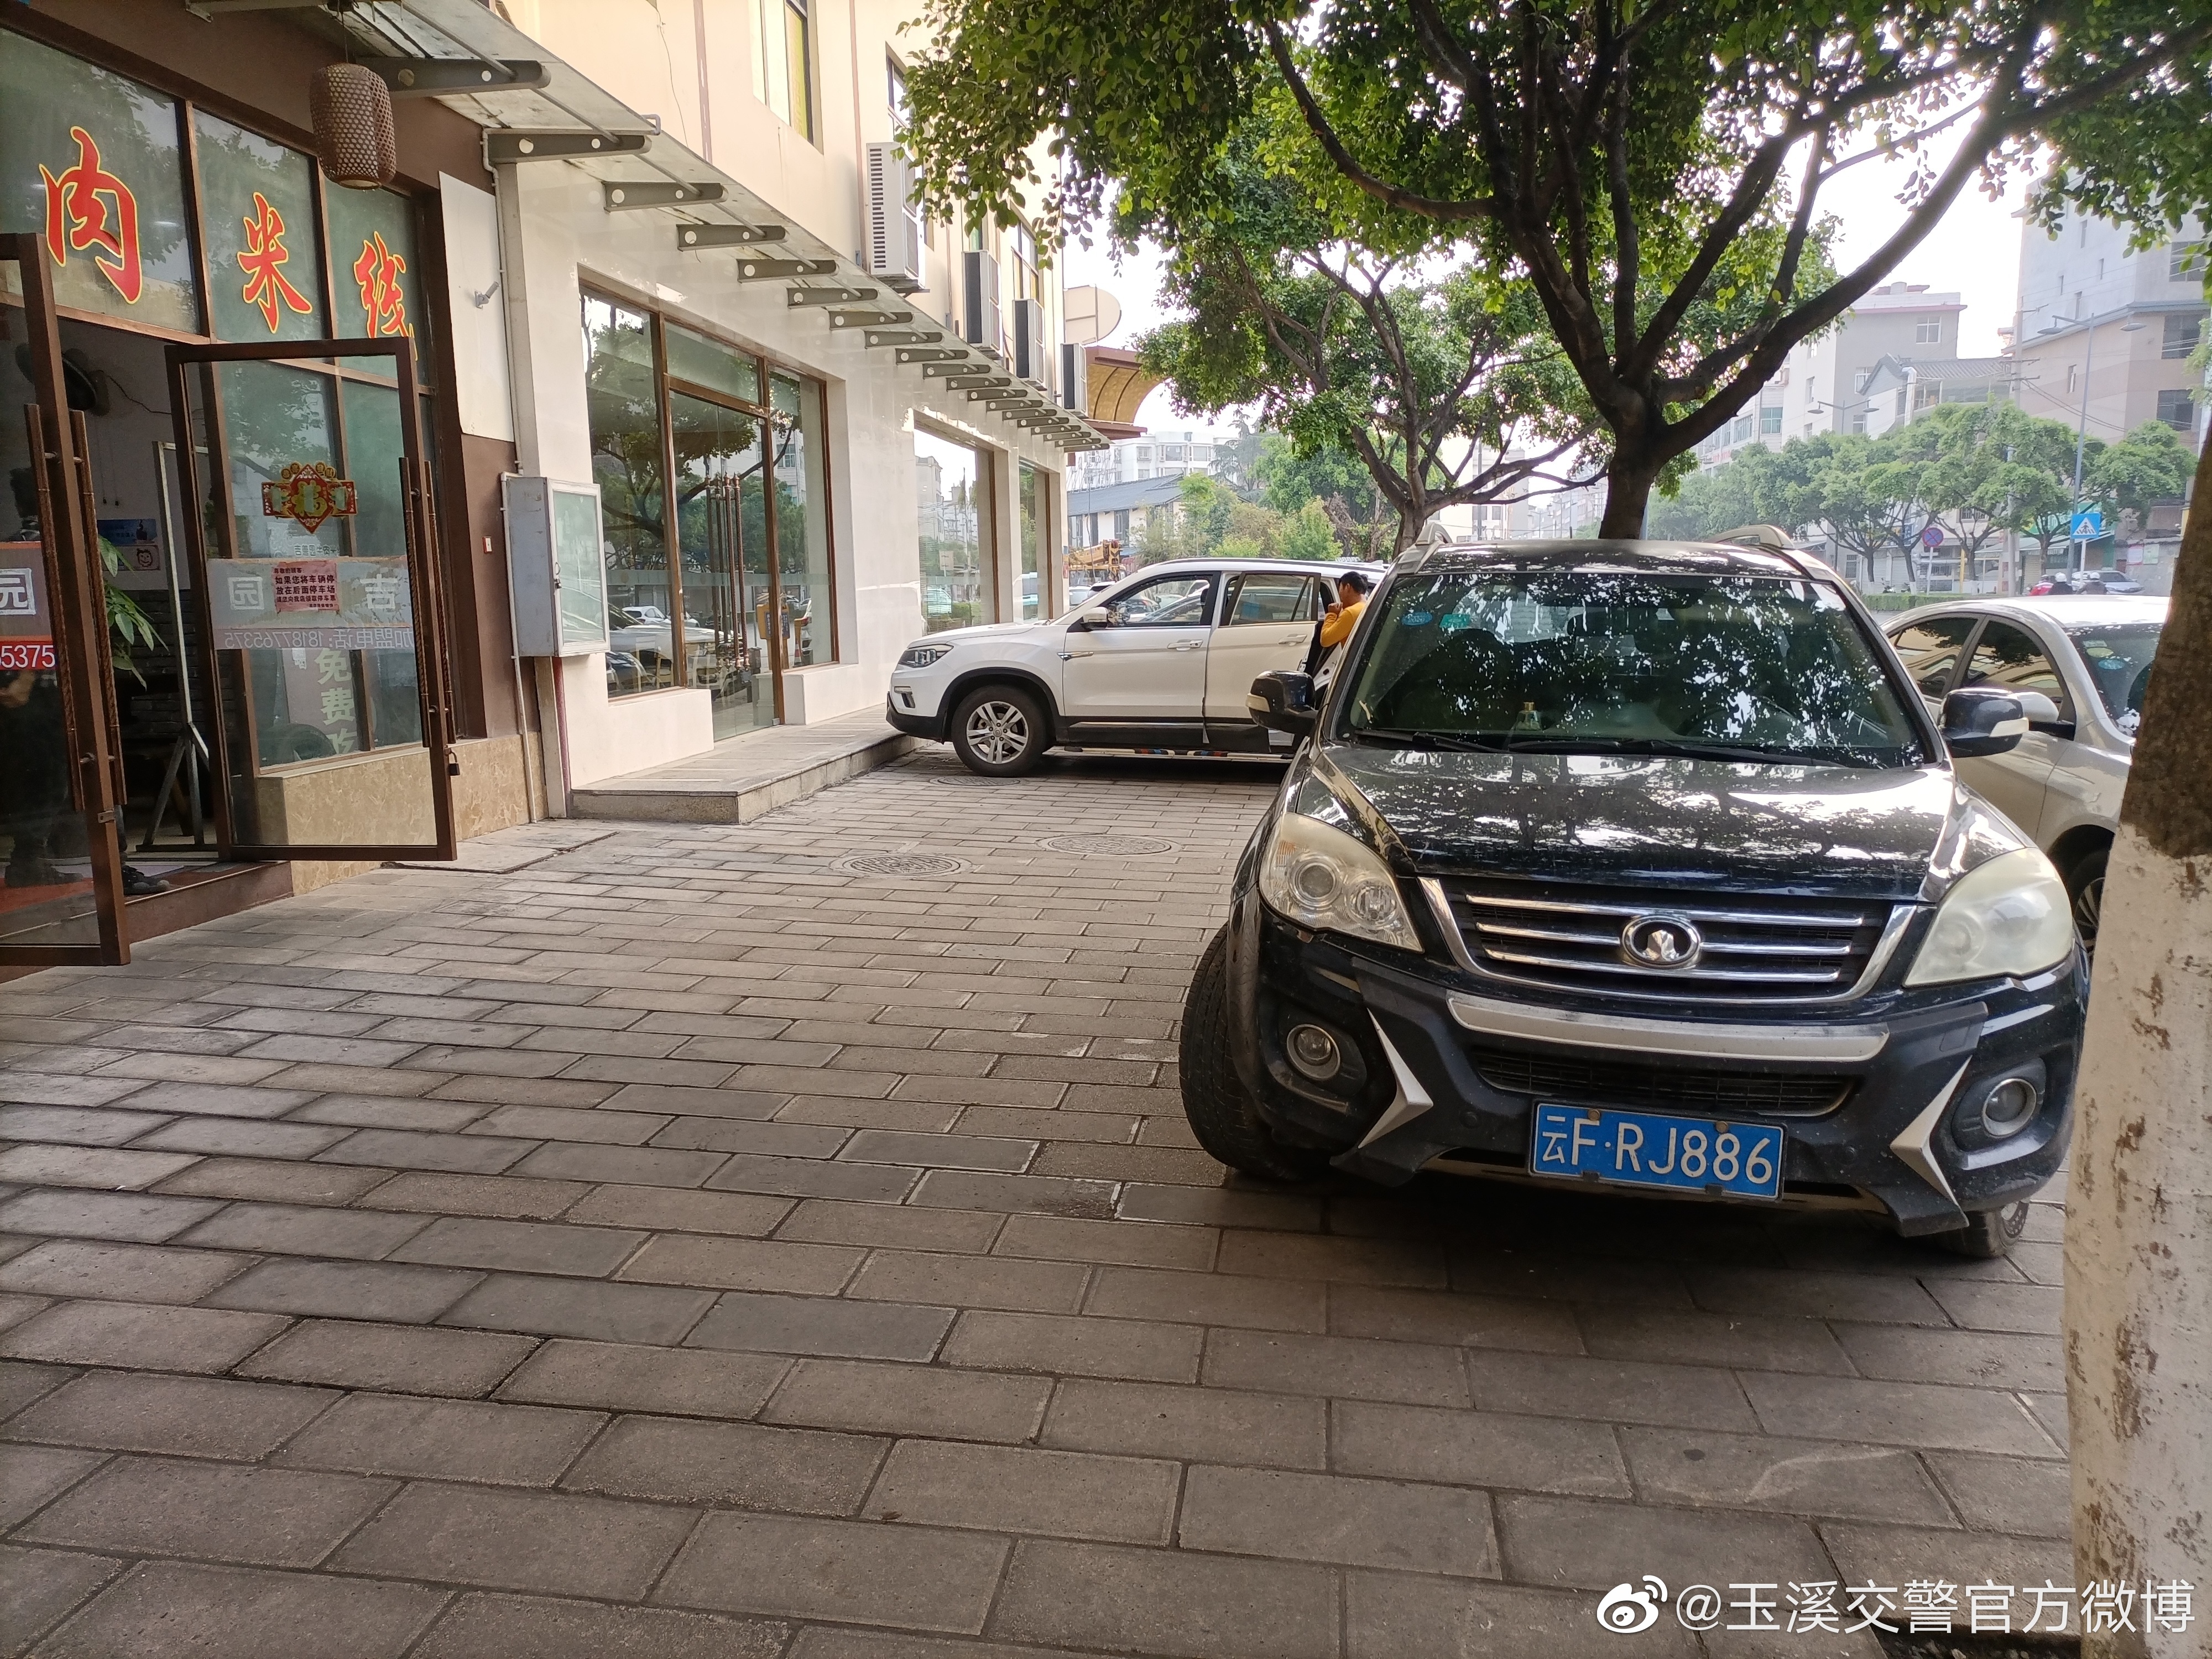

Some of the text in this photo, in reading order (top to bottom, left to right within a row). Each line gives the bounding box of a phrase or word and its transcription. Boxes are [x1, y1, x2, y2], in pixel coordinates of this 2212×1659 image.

[39, 126, 418, 361] 肉米线
[275, 575, 335, 585] 如果您将车辆停
[275, 585, 335, 595] 放在后面停车场
[0, 645, 55, 668] 5375
[1542, 1116, 1772, 1185] 云F·RJ886
